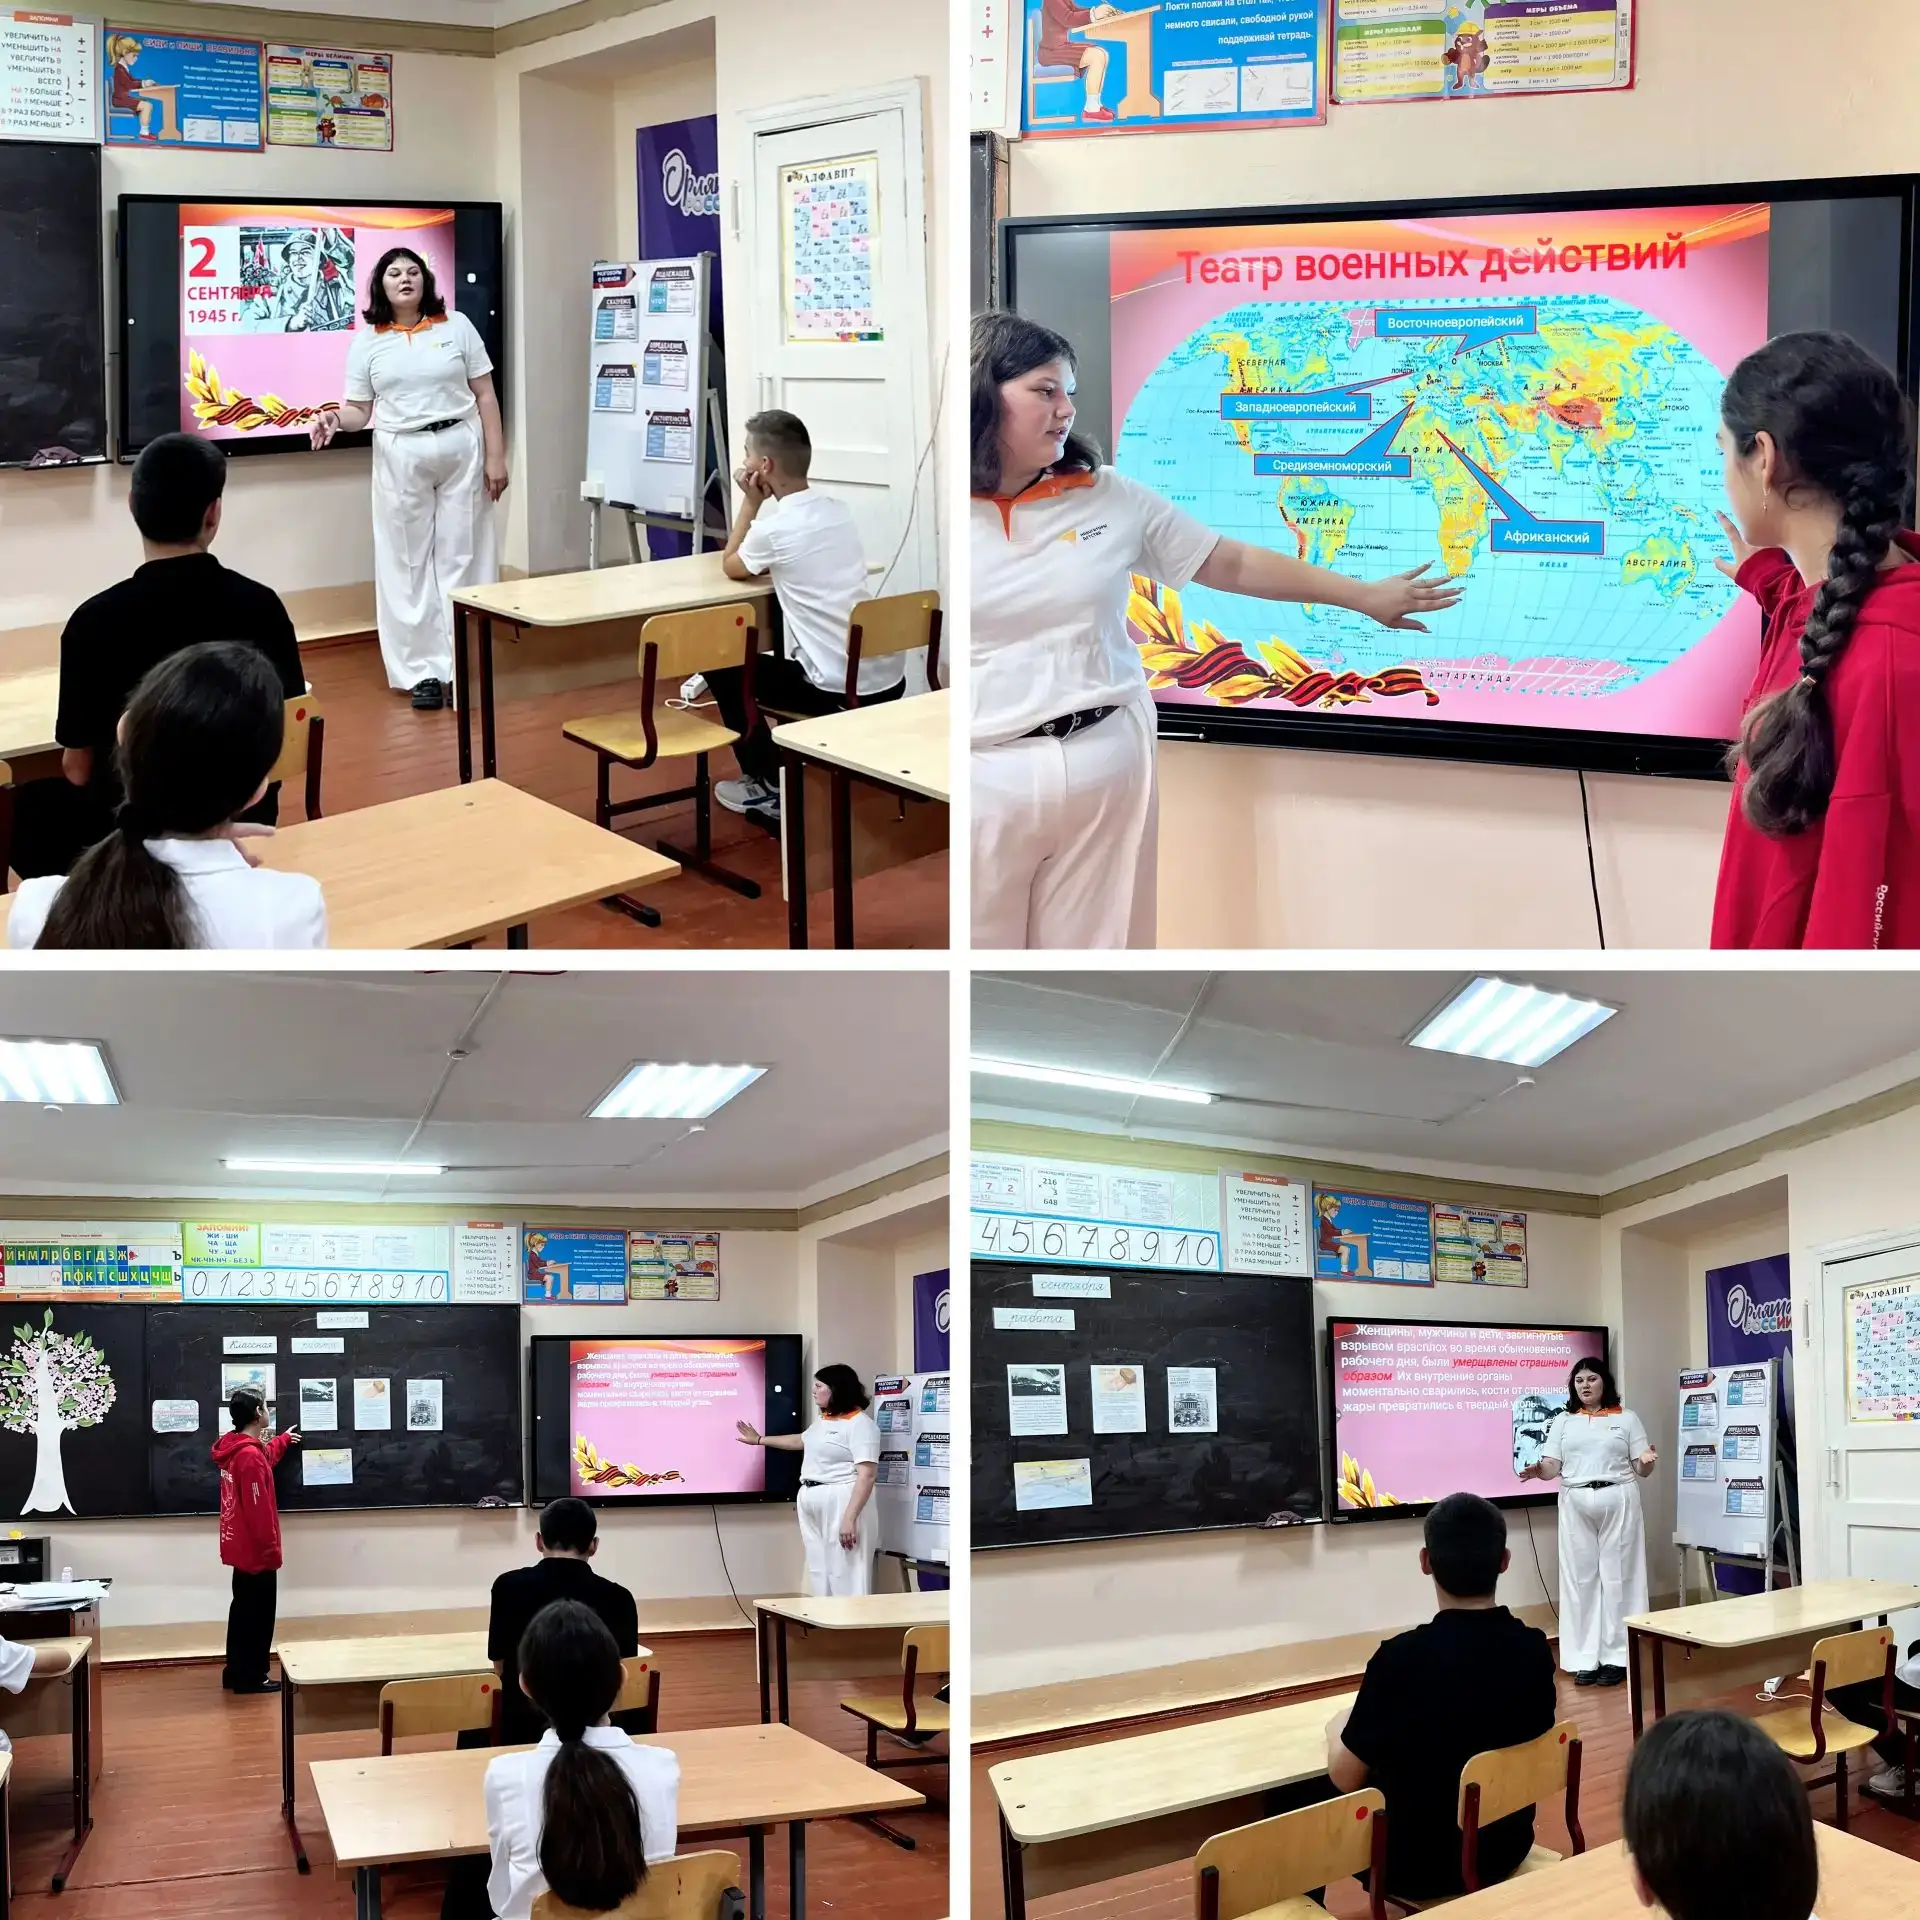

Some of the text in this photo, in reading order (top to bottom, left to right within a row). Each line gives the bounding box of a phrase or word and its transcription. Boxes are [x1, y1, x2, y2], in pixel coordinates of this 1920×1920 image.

[1191, 0, 1224, 11] положи
[1526, 6, 1548, 14] МЕРЫ
[1164, 10, 1314, 31] немного свисали, свободной рукой
[1218, 32, 1275, 45] поддерживай
[37, 77, 62, 86] ВСЕГО
[30, 87, 62, 97] БОЛЬШЕ
[29, 98, 62, 107] МЕНЬШЕ
[30, 109, 62, 118] БОЛЬШЕ
[30, 120, 62, 129] МЕНЬШЕ
[803, 168, 856, 184] АЛФАВИТ
[187, 236, 217, 280] 2
[1176, 232, 1688, 291] Театр военных действий
[187, 286, 273, 301] СЕНТЯБРЯ
[188, 308, 227, 324] 1945
[1387, 315, 1525, 332] Восточноевропейский
[1240, 358, 1287, 367] СЕВЕРНАЯ
[1523, 382, 1577, 391] АЗИЯ
[1235, 400, 1357, 416] Западноевропейский
[1273, 459, 1393, 476] Средиземноморский
[1300, 499, 1340, 508] ЮЖНАЯ
[1295, 517, 1345, 526] АМЕРИКА
[1504, 531, 1590, 546] Африканский
[1626, 558, 1687, 570] АВСТРАЛИЯ
[1428, 671, 1512, 682] АНТАРКТИДА
[1043, 1177, 1058, 1186] 216
[981, 1217, 998, 1251] 4
[1008, 1219, 1034, 1254] 5
[1043, 1222, 1065, 1255] 6
[1078, 1226, 1099, 1258] 7
[1109, 1228, 1130, 1260] 8
[1140, 1231, 1160, 1263] 9
[220, 1271, 231, 1297] 1
[237, 1271, 254, 1297] 2
[259, 1271, 276, 1297] 3
[302, 1272, 320, 1298] 5
[324, 1273, 341, 1298] 6
[347, 1273, 362, 1299] 7
[367, 1273, 382, 1299] 8
[390, 1273, 405, 1299] 9
[1040, 1277, 1105, 1296] сентября
[1864, 1285, 1912, 1301] АЛФАВИТ
[1356, 1324, 1415, 1339] Женщины,
[1418, 1327, 1467, 1340] мужчины
[1480, 1331, 1503, 1341] дети,
[1504, 1331, 1563, 1342] застигнутые
[230, 1340, 272, 1351] Классная
[1340, 1341, 1572, 1355] взрывом врасплох во время обыкновенного
[1341, 1355, 1569, 1369] рабочего дня, были умерщвлены страшным
[1397, 1371, 1411, 1381] Их
[1414, 1371, 1475, 1384] внутренние
[1477, 1372, 1513, 1382] органы
[1342, 1384, 1570, 1398] моментально сварились, кости от страшной
[1343, 1402, 1376, 1414] жары
[1378, 1401, 1454, 1414] превратились
[1466, 1399, 1509, 1412] твердый
